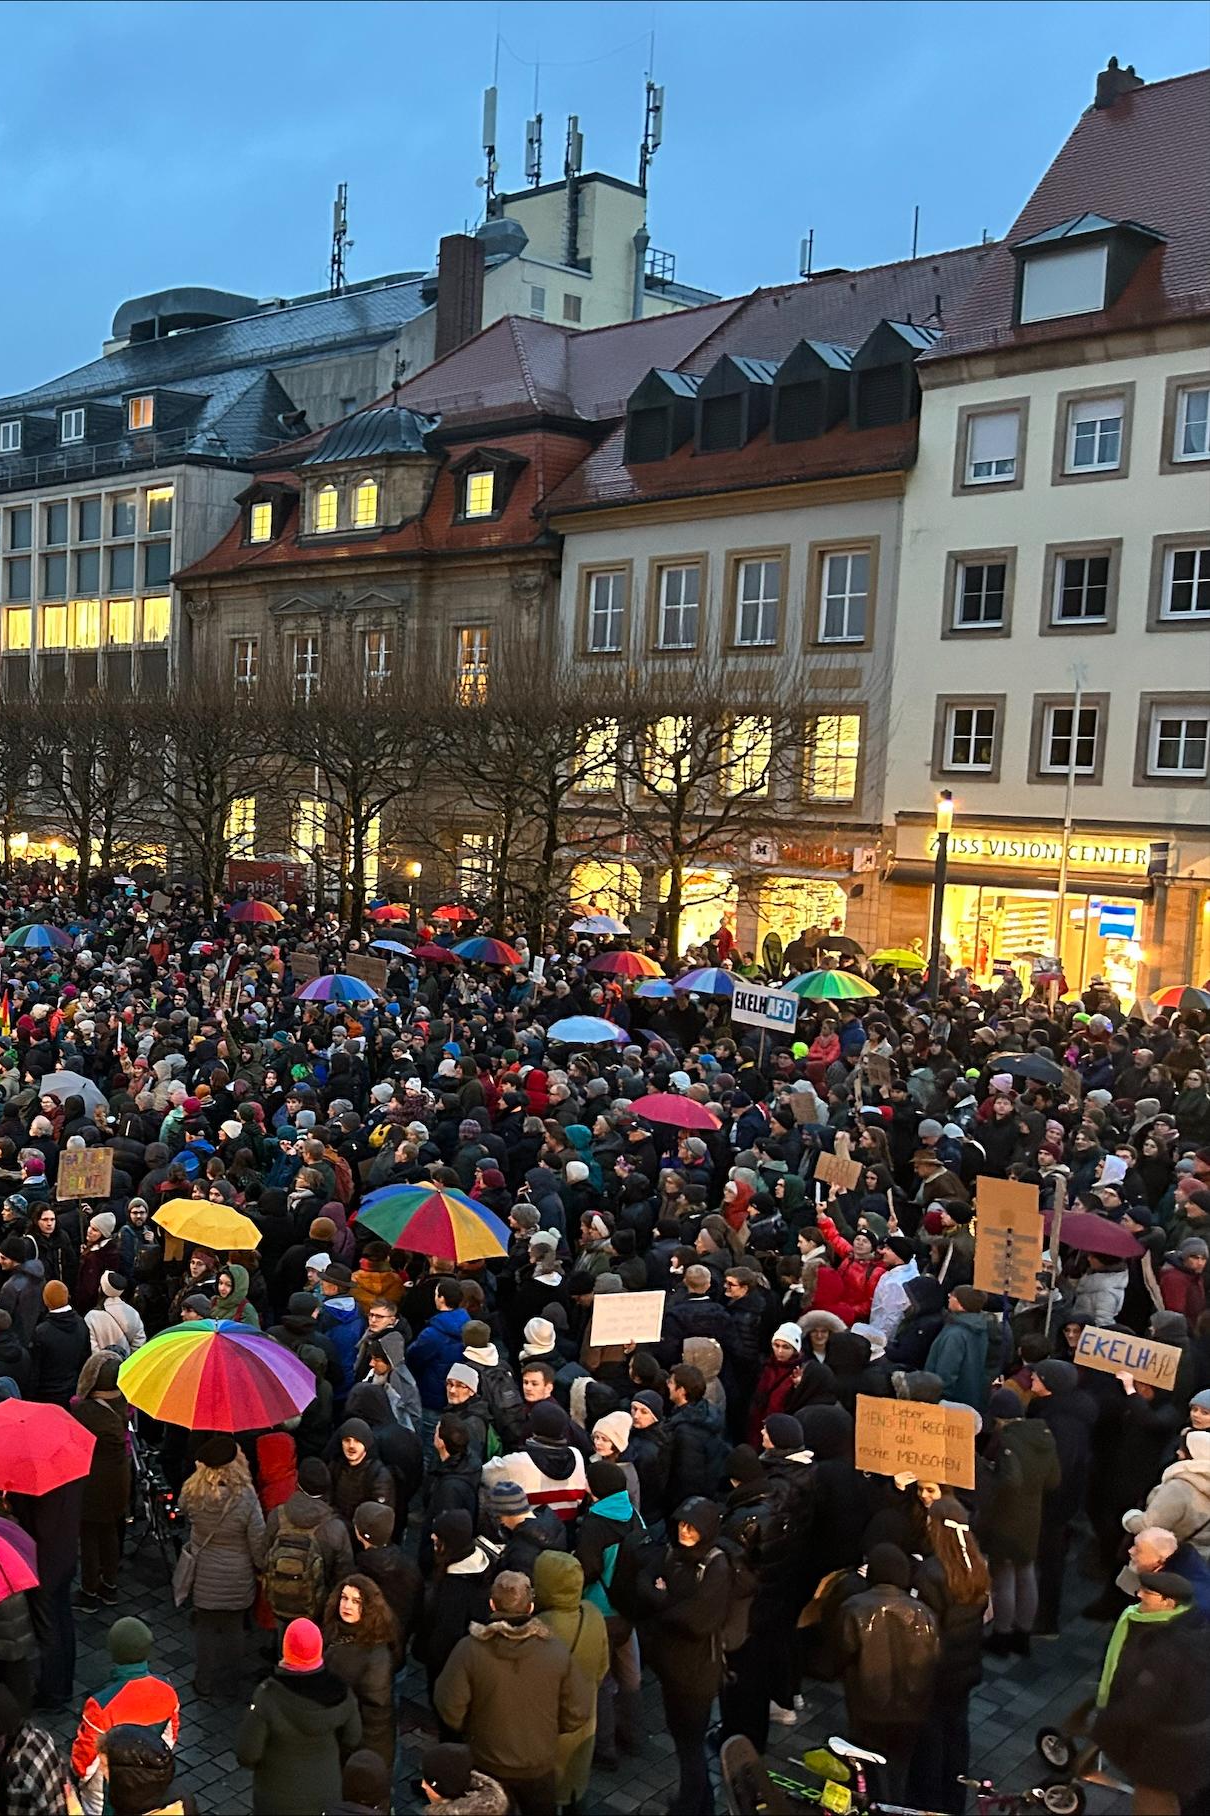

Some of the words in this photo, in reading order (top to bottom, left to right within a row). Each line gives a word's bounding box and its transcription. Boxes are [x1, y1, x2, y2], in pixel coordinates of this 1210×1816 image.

[930, 837, 979, 854] ZISS
[987, 840, 1057, 859] VISION
[1067, 845, 1147, 865] CENTER
[734, 991, 793, 1020] EKELHAFD
[894, 1434, 914, 1445] als
[896, 1449, 961, 1472] MENSCHEN
